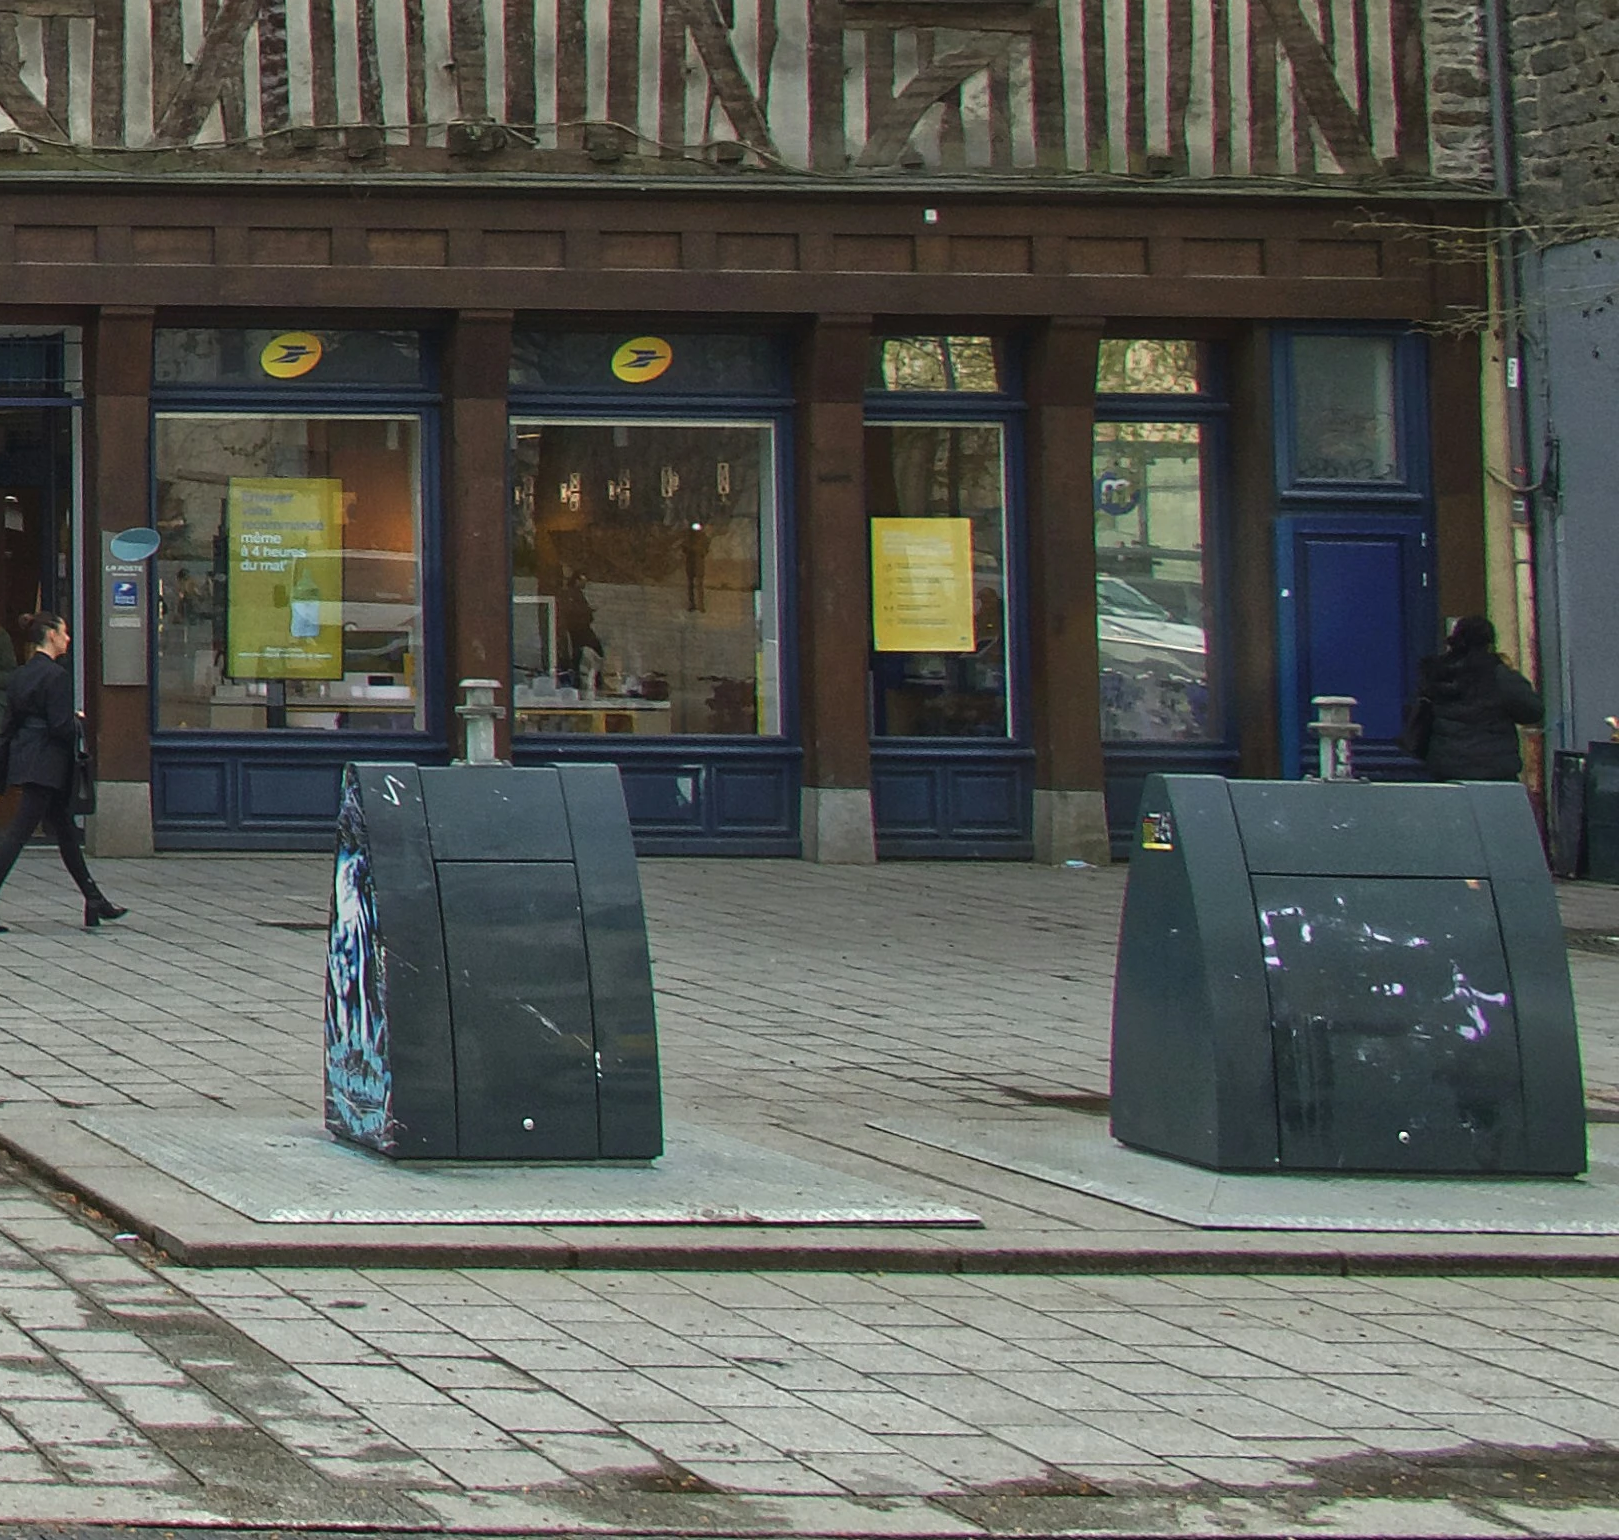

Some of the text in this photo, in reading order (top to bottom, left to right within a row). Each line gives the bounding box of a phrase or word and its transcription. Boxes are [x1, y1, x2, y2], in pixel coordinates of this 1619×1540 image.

[240, 531, 282, 544] même
[240, 545, 308, 558] à 4 heures
[240, 559, 257, 571] du
